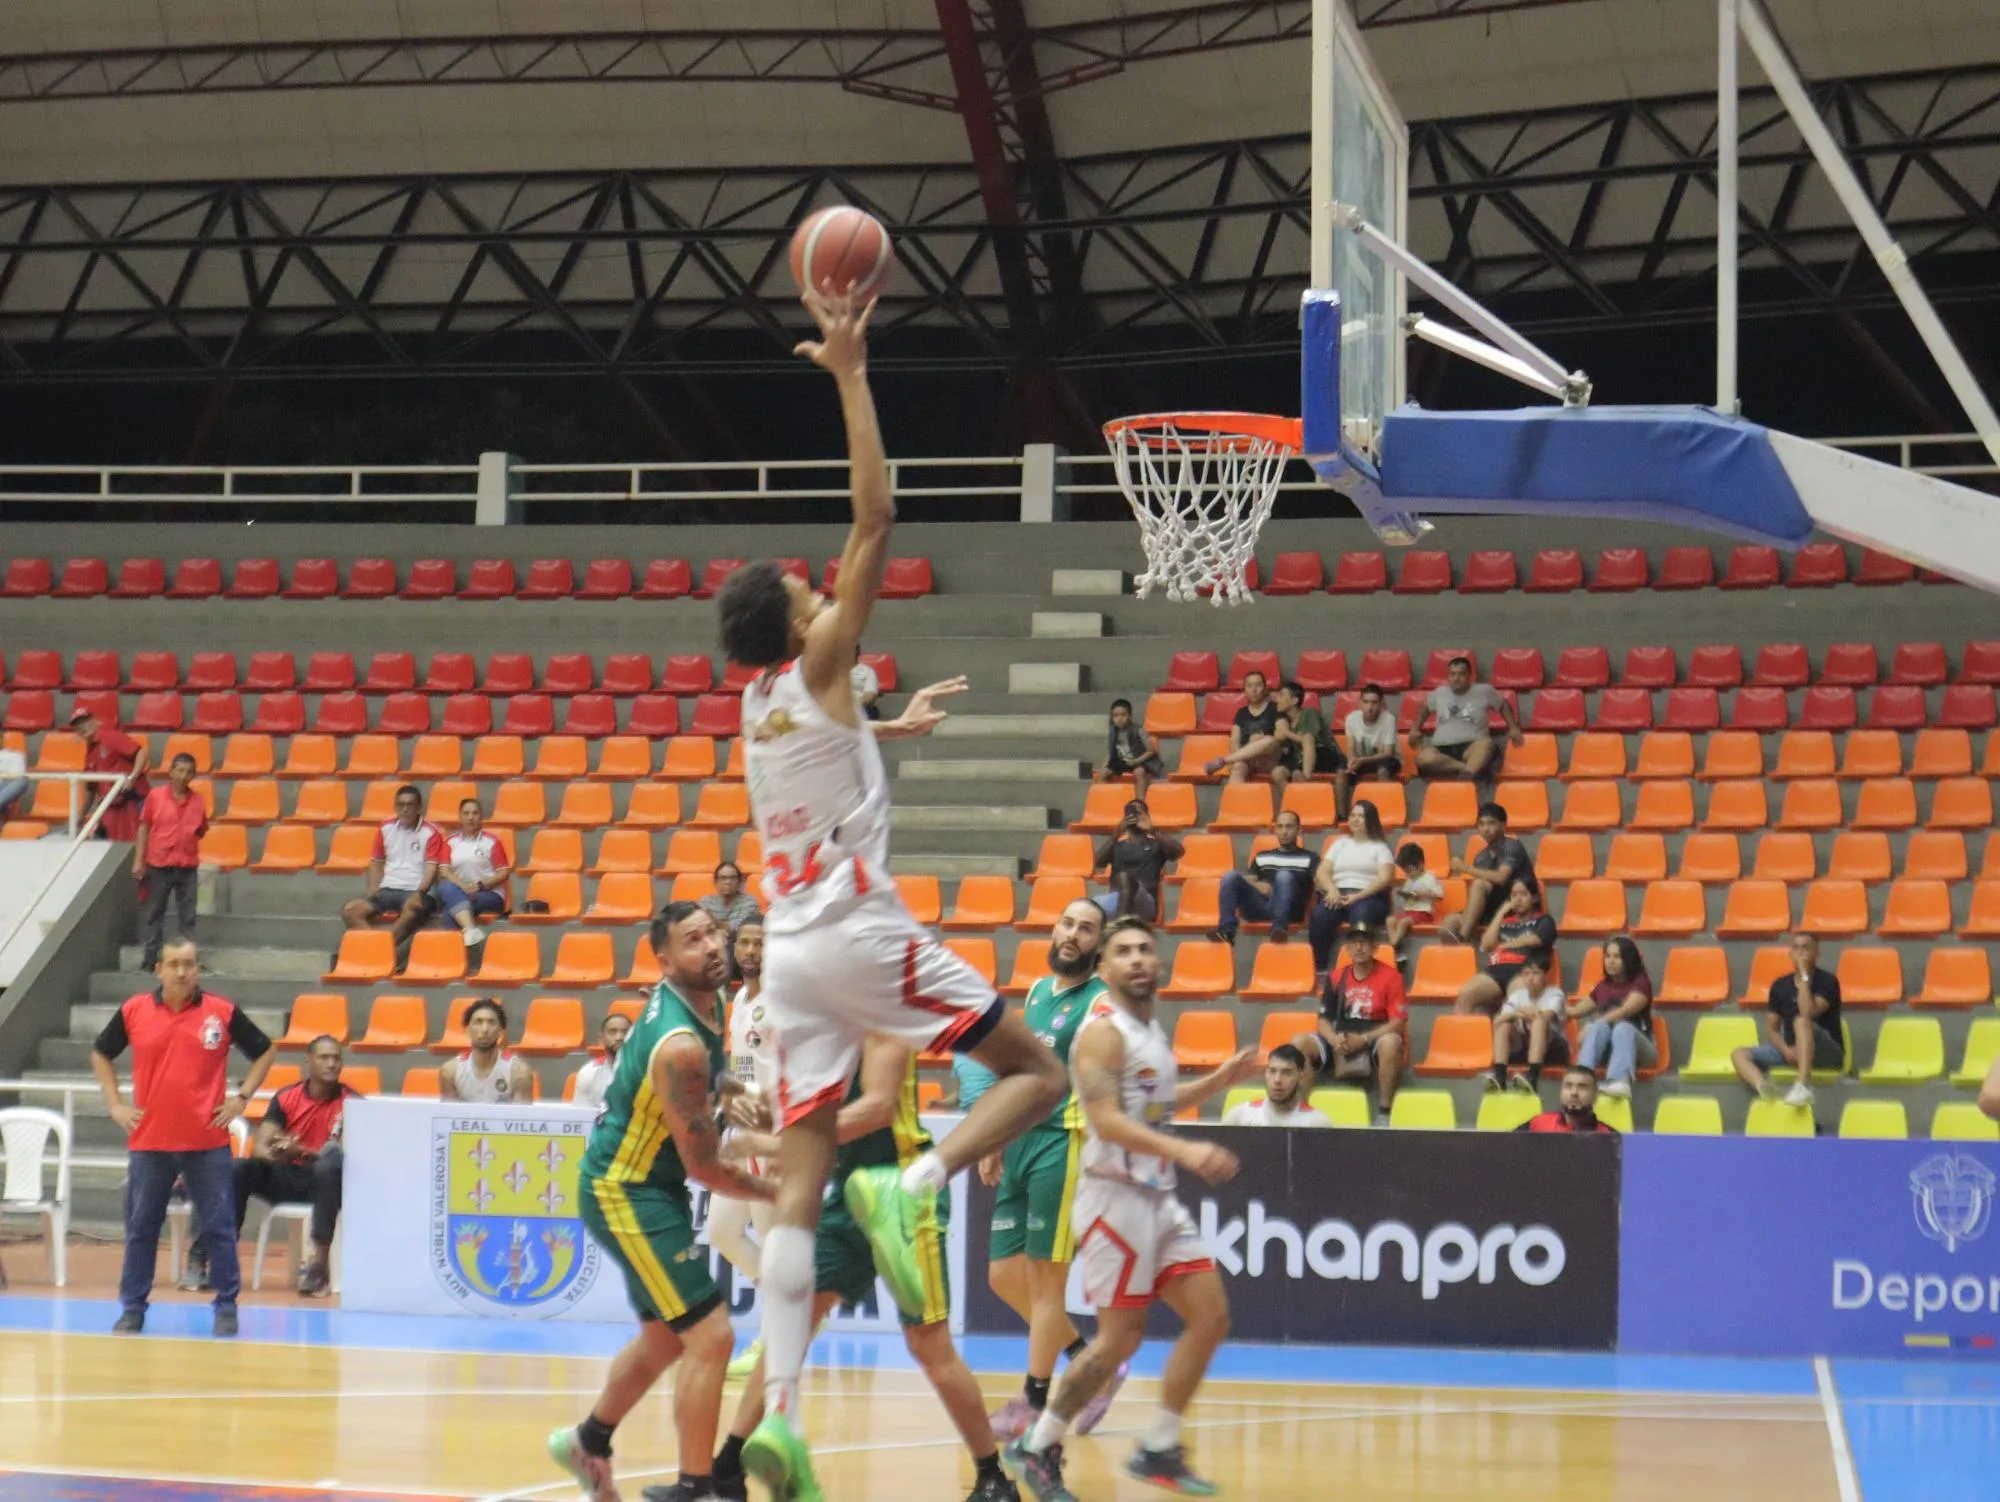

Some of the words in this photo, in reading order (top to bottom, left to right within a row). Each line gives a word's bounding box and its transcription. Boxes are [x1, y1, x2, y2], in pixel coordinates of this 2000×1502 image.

[435, 1133, 445, 1142] Y
[451, 1120, 489, 1132] LEAL
[504, 1122, 549, 1133] VILLA
[562, 1123, 583, 1134] DE
[434, 1146, 446, 1218] VALEROSA
[434, 1221, 447, 1269] NOBLE
[1200, 1198, 1566, 1300] khanpro
[443, 1273, 470, 1299] MUY
[562, 1243, 597, 1302] CUCUTA
